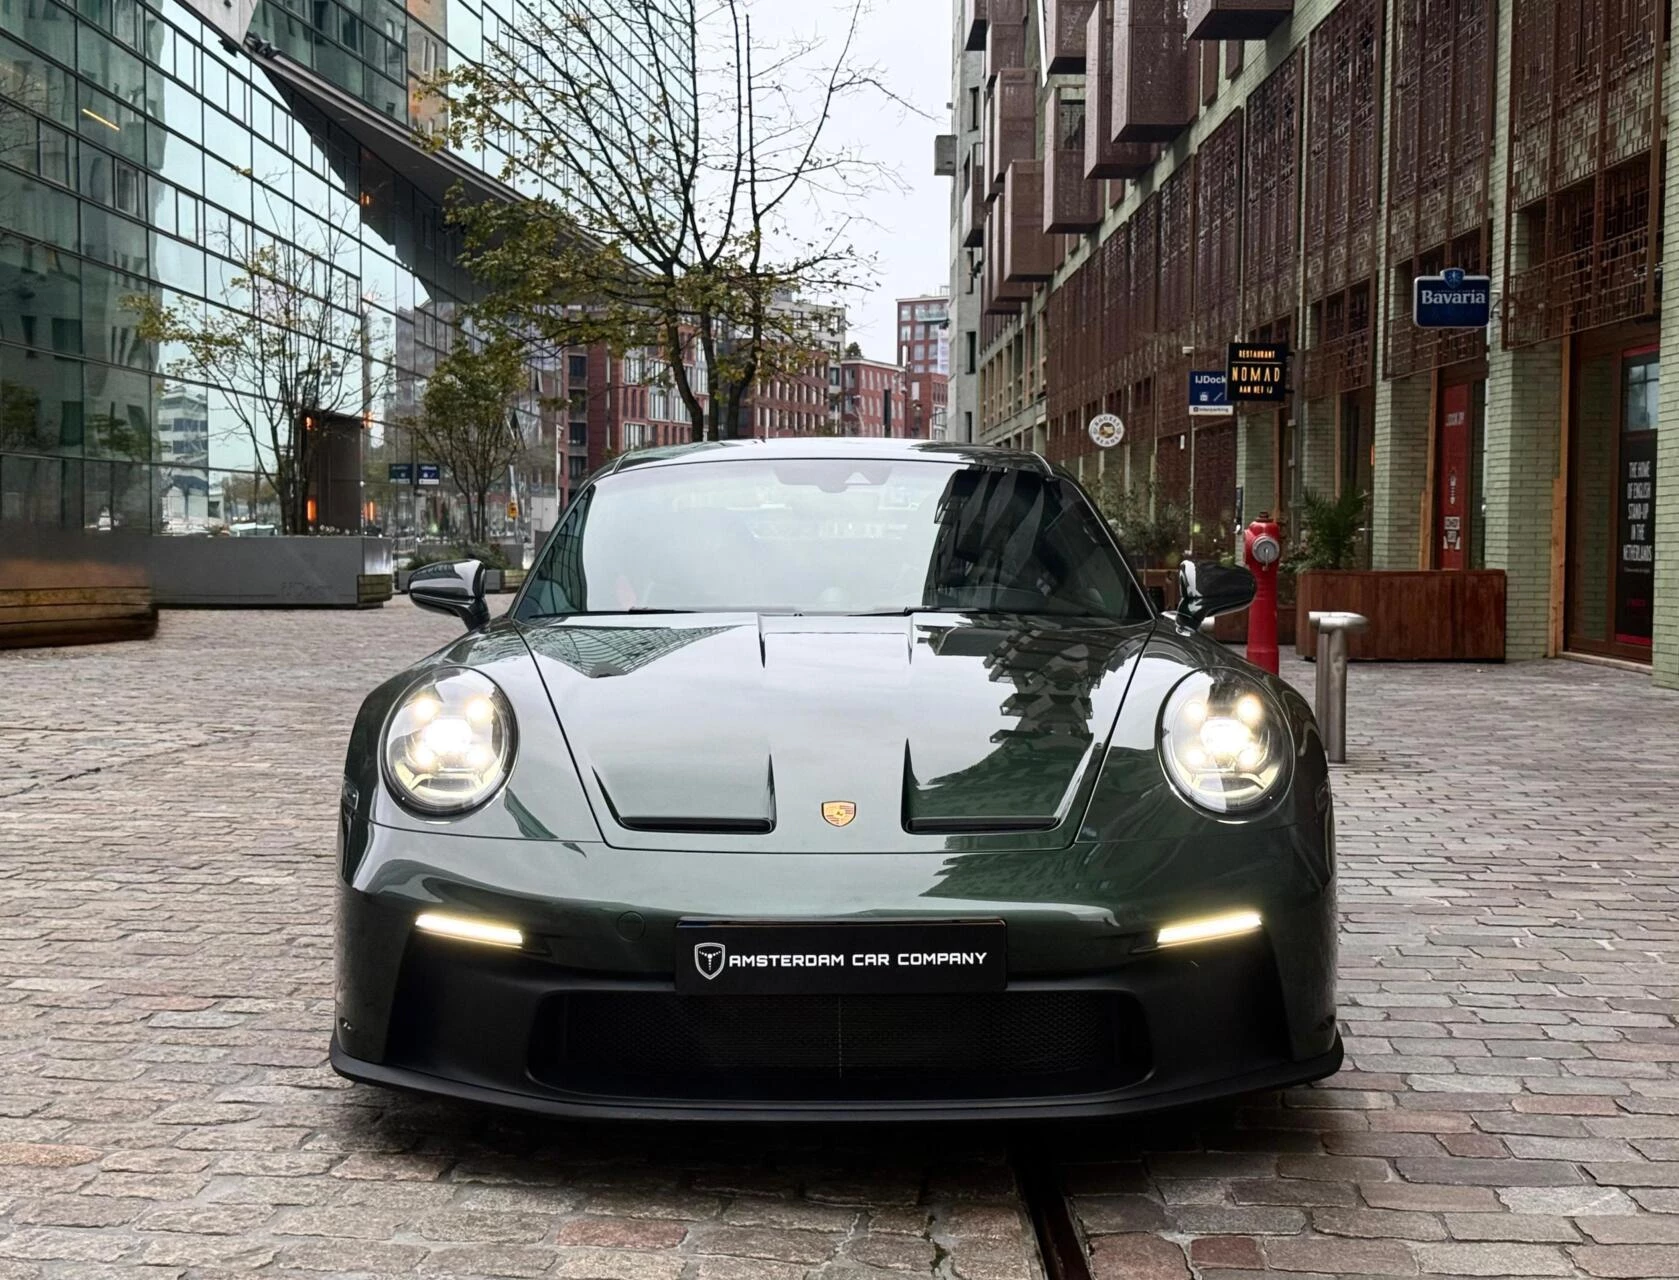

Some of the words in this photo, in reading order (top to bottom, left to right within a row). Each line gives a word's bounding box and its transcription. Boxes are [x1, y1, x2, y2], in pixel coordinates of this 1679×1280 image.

[1421, 289, 1486, 304] Bavaria
[1238, 349, 1276, 359] RESTAURANT
[1231, 366, 1281, 382] NOMAD
[1623, 544, 1652, 562] NETHERLANDS
[728, 953, 845, 968] AMSTERDAM
[852, 952, 890, 966] CAR
[897, 951, 988, 965] COMPANY
